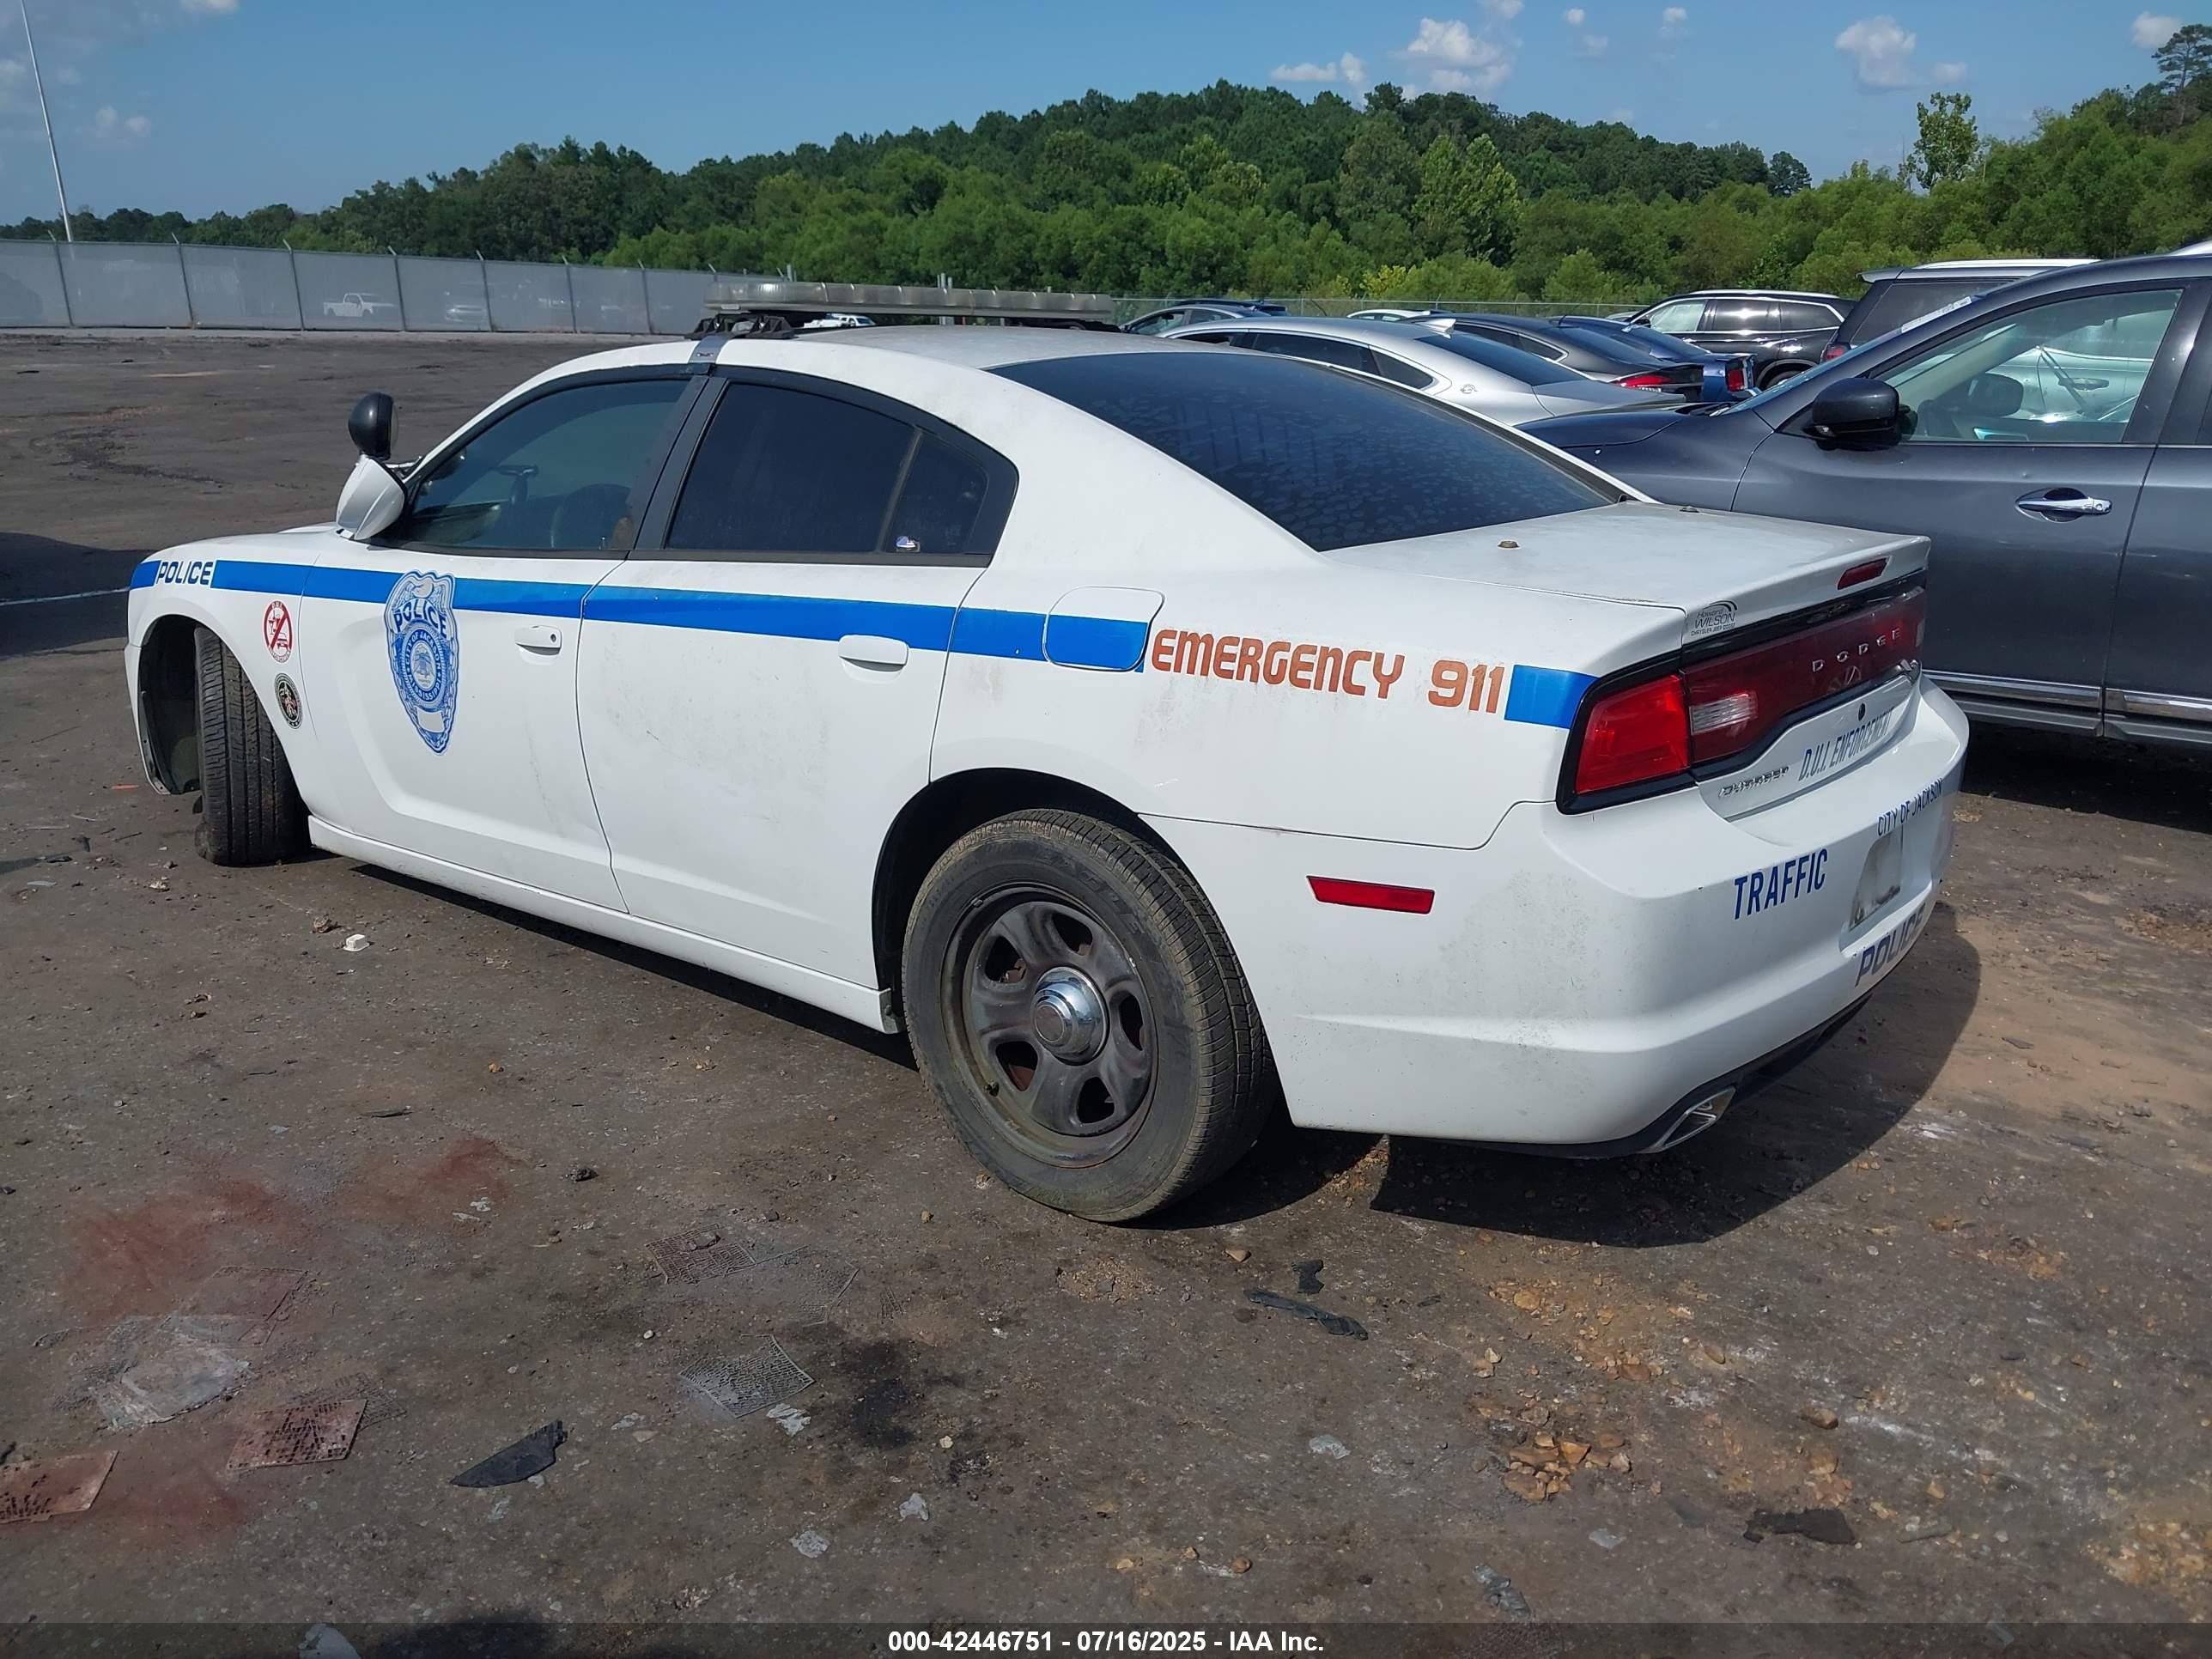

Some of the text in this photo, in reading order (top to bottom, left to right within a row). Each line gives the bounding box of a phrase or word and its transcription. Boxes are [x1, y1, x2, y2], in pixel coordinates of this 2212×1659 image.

[156, 561, 213, 585] POLICE
[392, 599, 447, 639] POLICE
[1694, 612, 1736, 629] WILSON
[1151, 629, 1505, 714] EMERGENCY 911
[1812, 628, 1900, 672] DODGE
[1877, 778, 1943, 836] CITY OF JACKSON
[1734, 848, 1828, 921] TRAFFIC
[1855, 902, 1926, 988] POLICE
